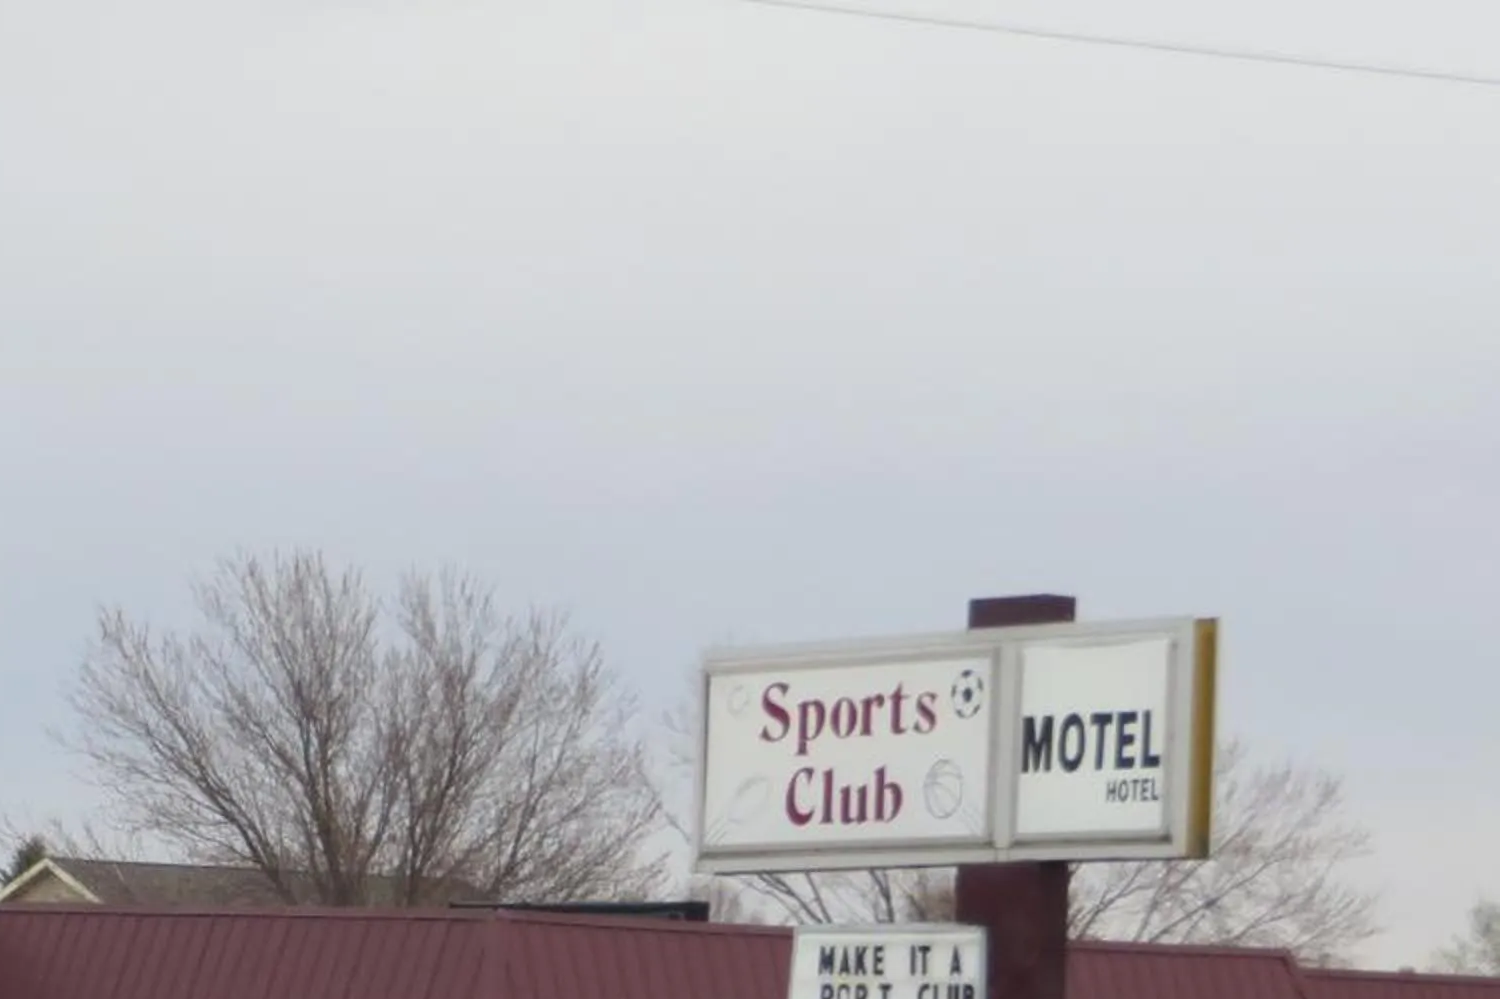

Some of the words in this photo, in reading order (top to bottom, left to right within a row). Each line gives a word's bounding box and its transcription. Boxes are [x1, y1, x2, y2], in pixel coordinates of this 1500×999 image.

[759, 681, 938, 756] Sports
[1021, 710, 1162, 774] MOTEL
[785, 764, 904, 827] Club
[1105, 777, 1160, 803] HOTEL
[818, 945, 885, 977] MAKE
[910, 945, 932, 977] IT
[950, 946, 963, 975] A
